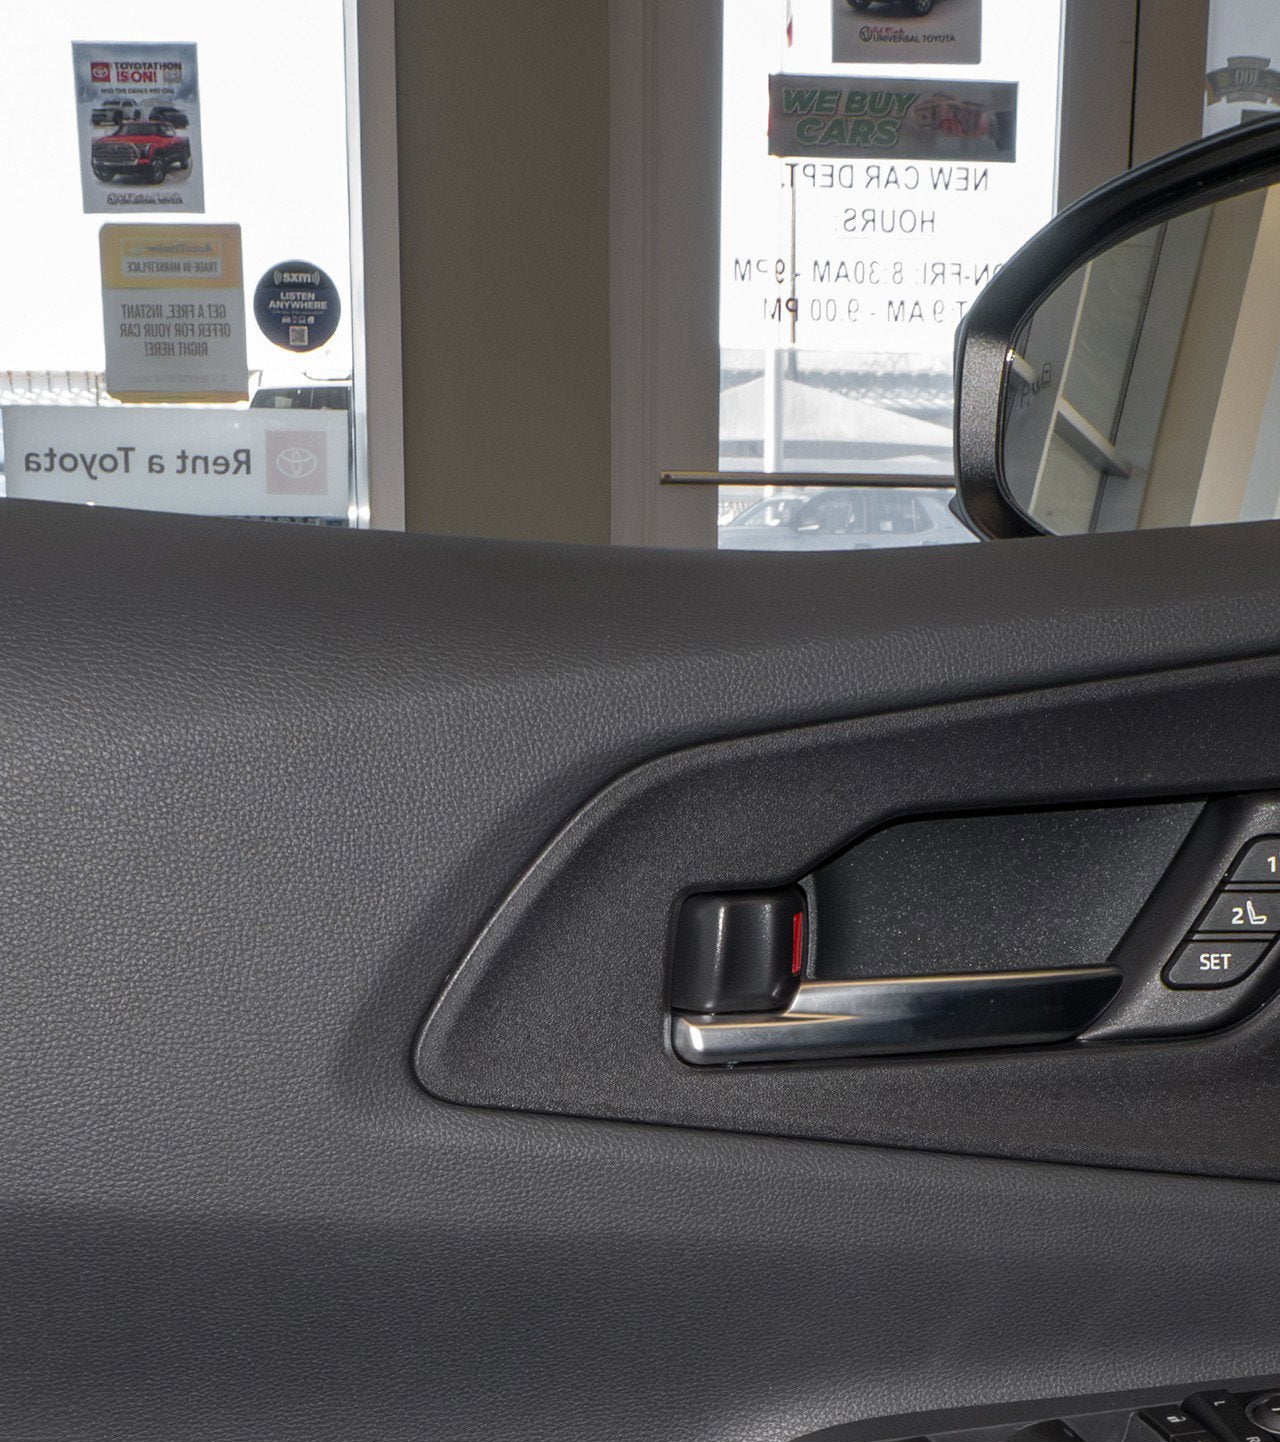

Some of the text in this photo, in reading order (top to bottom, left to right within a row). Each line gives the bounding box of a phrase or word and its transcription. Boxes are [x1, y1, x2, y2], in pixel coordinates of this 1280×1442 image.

[873, 33, 956, 43] UNIVERSAL TOYOTA
[114, 62, 183, 71] TOYOTATHON
[116, 71, 157, 83] IS ON!
[782, 87, 919, 117] WE BUY
[795, 116, 900, 148] CARS
[282, 272, 312, 283] sxm
[280, 291, 316, 301] LISTEN
[269, 300, 328, 310] ANYWHERE
[1267, 856, 1277, 873] 1
[1231, 907, 1245, 925] 2
[1199, 953, 1232, 971] SET
[1213, 1399, 1226, 1407] L
